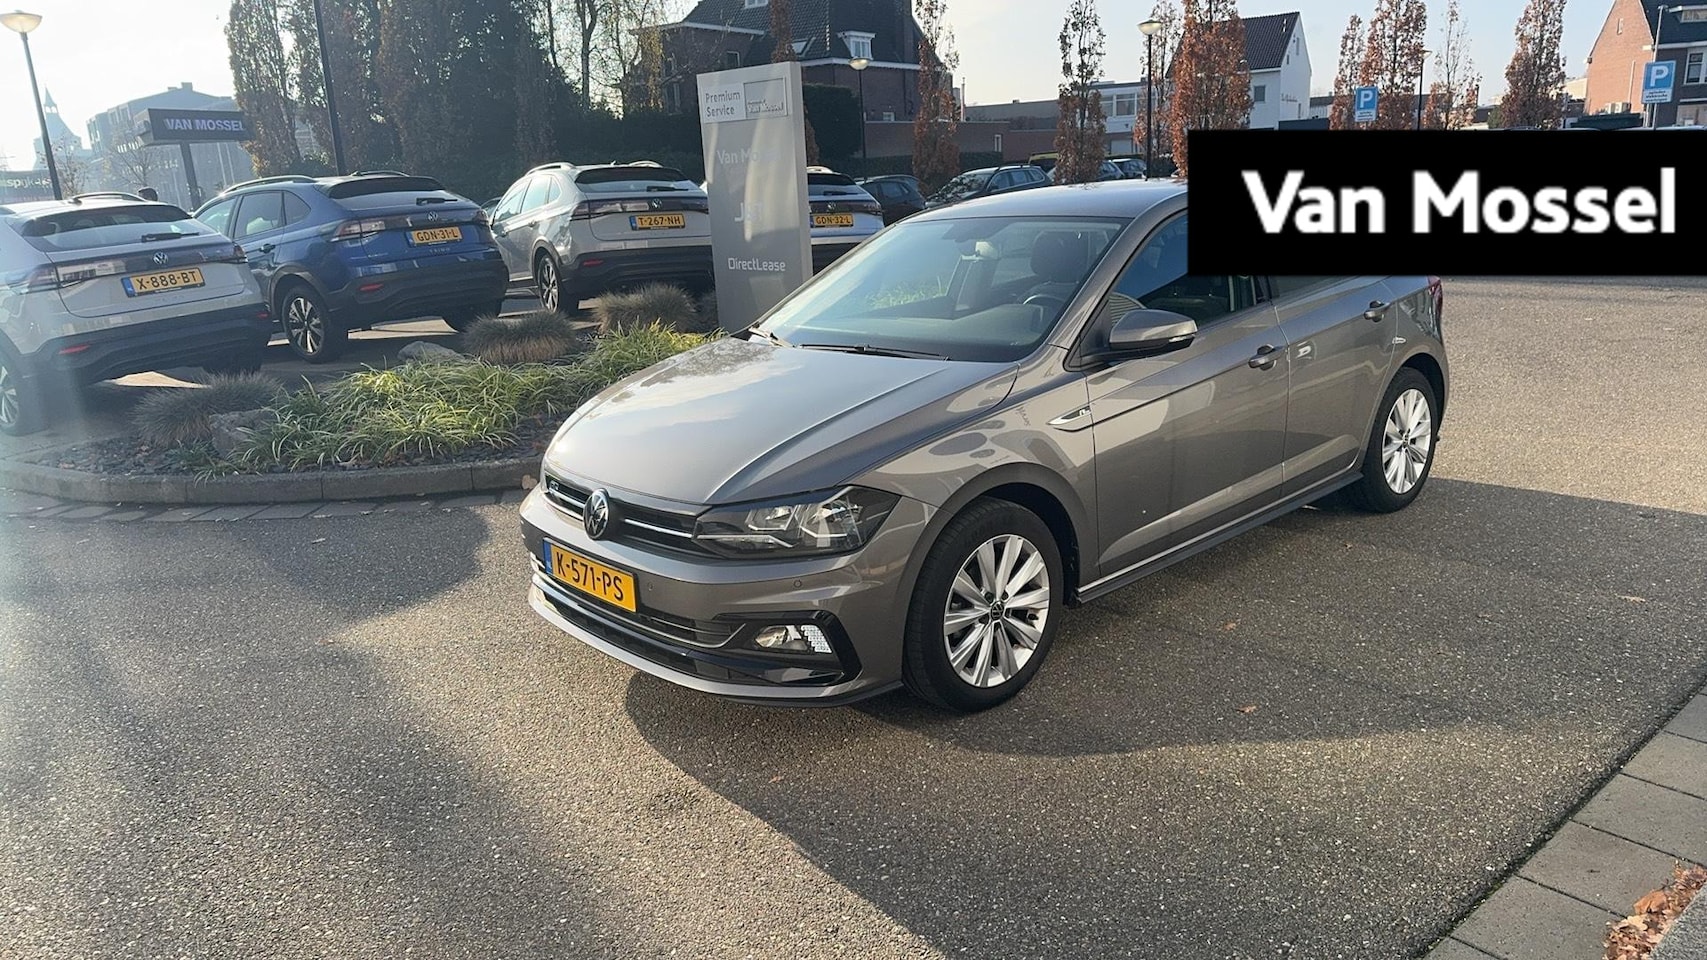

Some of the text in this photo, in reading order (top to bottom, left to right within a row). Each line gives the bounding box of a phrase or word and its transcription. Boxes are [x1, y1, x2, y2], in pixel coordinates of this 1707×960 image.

[1650, 65, 1669, 87] P
[705, 91, 741, 103] Premium
[1360, 90, 1373, 108] P
[706, 105, 735, 117] Service
[165, 119, 246, 131] VAN MOSSEL
[716, 149, 738, 164] Van
[638, 216, 681, 226] T-267-NH
[416, 229, 459, 242] GDN-31-L
[727, 257, 786, 272] DirectLease
[136, 271, 198, 290] X-888-BT
[556, 551, 624, 601] K-571-PS
